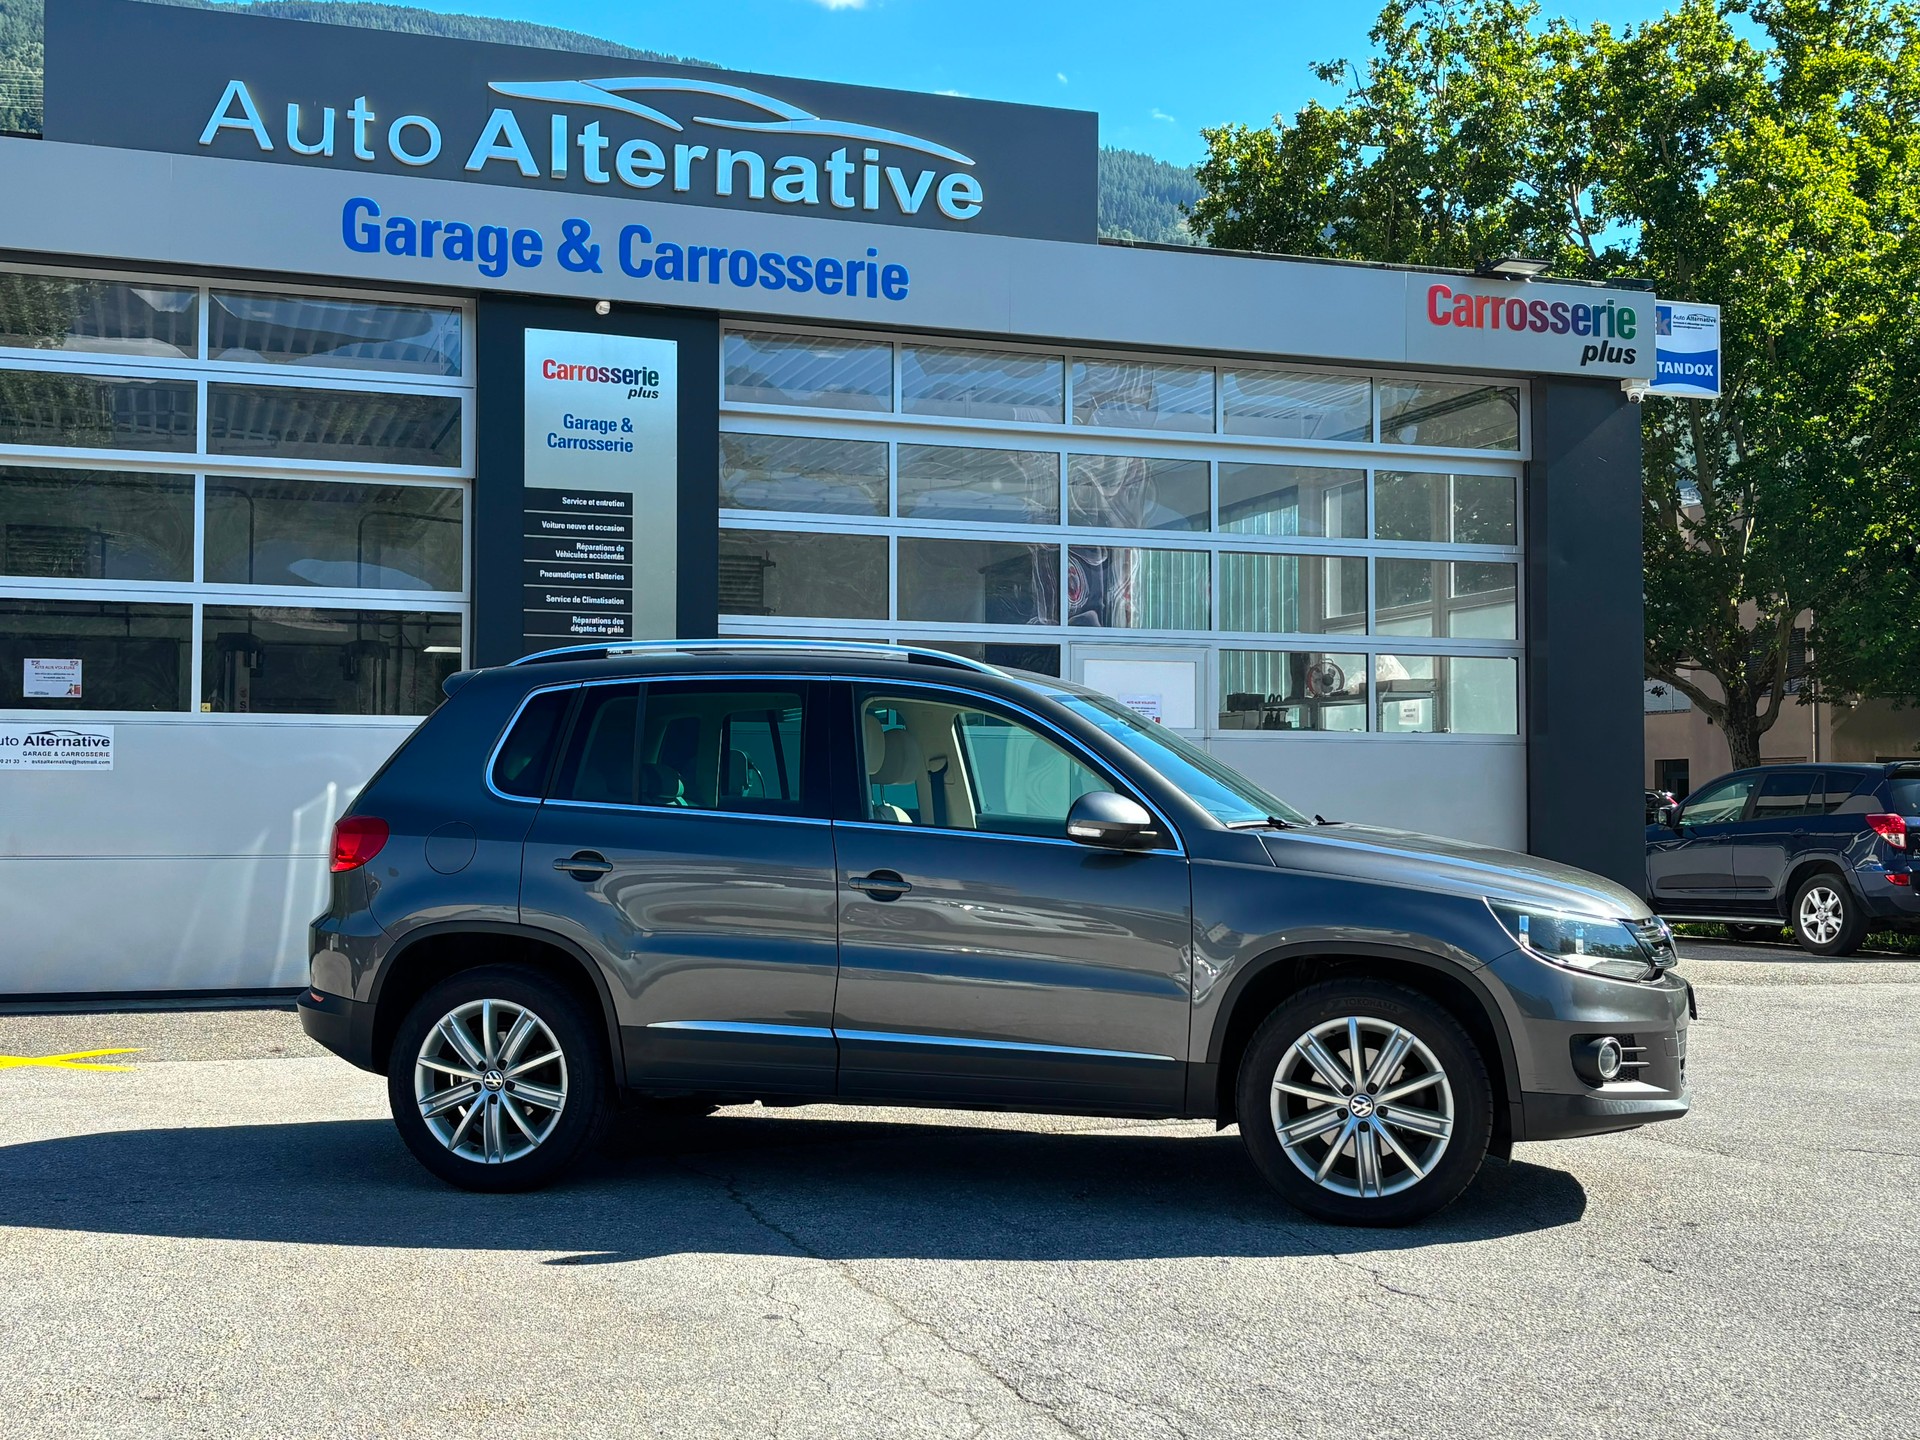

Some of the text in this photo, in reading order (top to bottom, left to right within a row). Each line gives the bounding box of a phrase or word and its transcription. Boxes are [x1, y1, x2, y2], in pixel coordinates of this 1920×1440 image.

[199, 80, 984, 220] Auto Alternative
[342, 196, 910, 301] Garage & Carrosserie
[1427, 284, 1637, 340] Carrosserie
[1580, 340, 1637, 366] plus
[543, 359, 659, 386] Carrosserie
[1656, 361, 1714, 377] TANDOX
[627, 387, 659, 400] plus
[563, 414, 634, 434] Garage &
[547, 432, 634, 452] Carrosserie
[562, 497, 587, 506] Service
[596, 499, 625, 508] entretien
[541, 521, 565, 529] Voiture
[595, 524, 625, 532] occasion
[576, 542, 625, 552] Réparations de
[555, 550, 625, 561] Véhicules accidentés
[540, 570, 586, 580] Pneumatiques
[595, 572, 625, 580] Batteries
[546, 594, 625, 605] Service de Climatisation
[572, 616, 625, 625] Réparations des
[597, 625, 606, 633] de
[607, 626, 625, 635] grêle
[23, 735, 110, 747] Alternative
